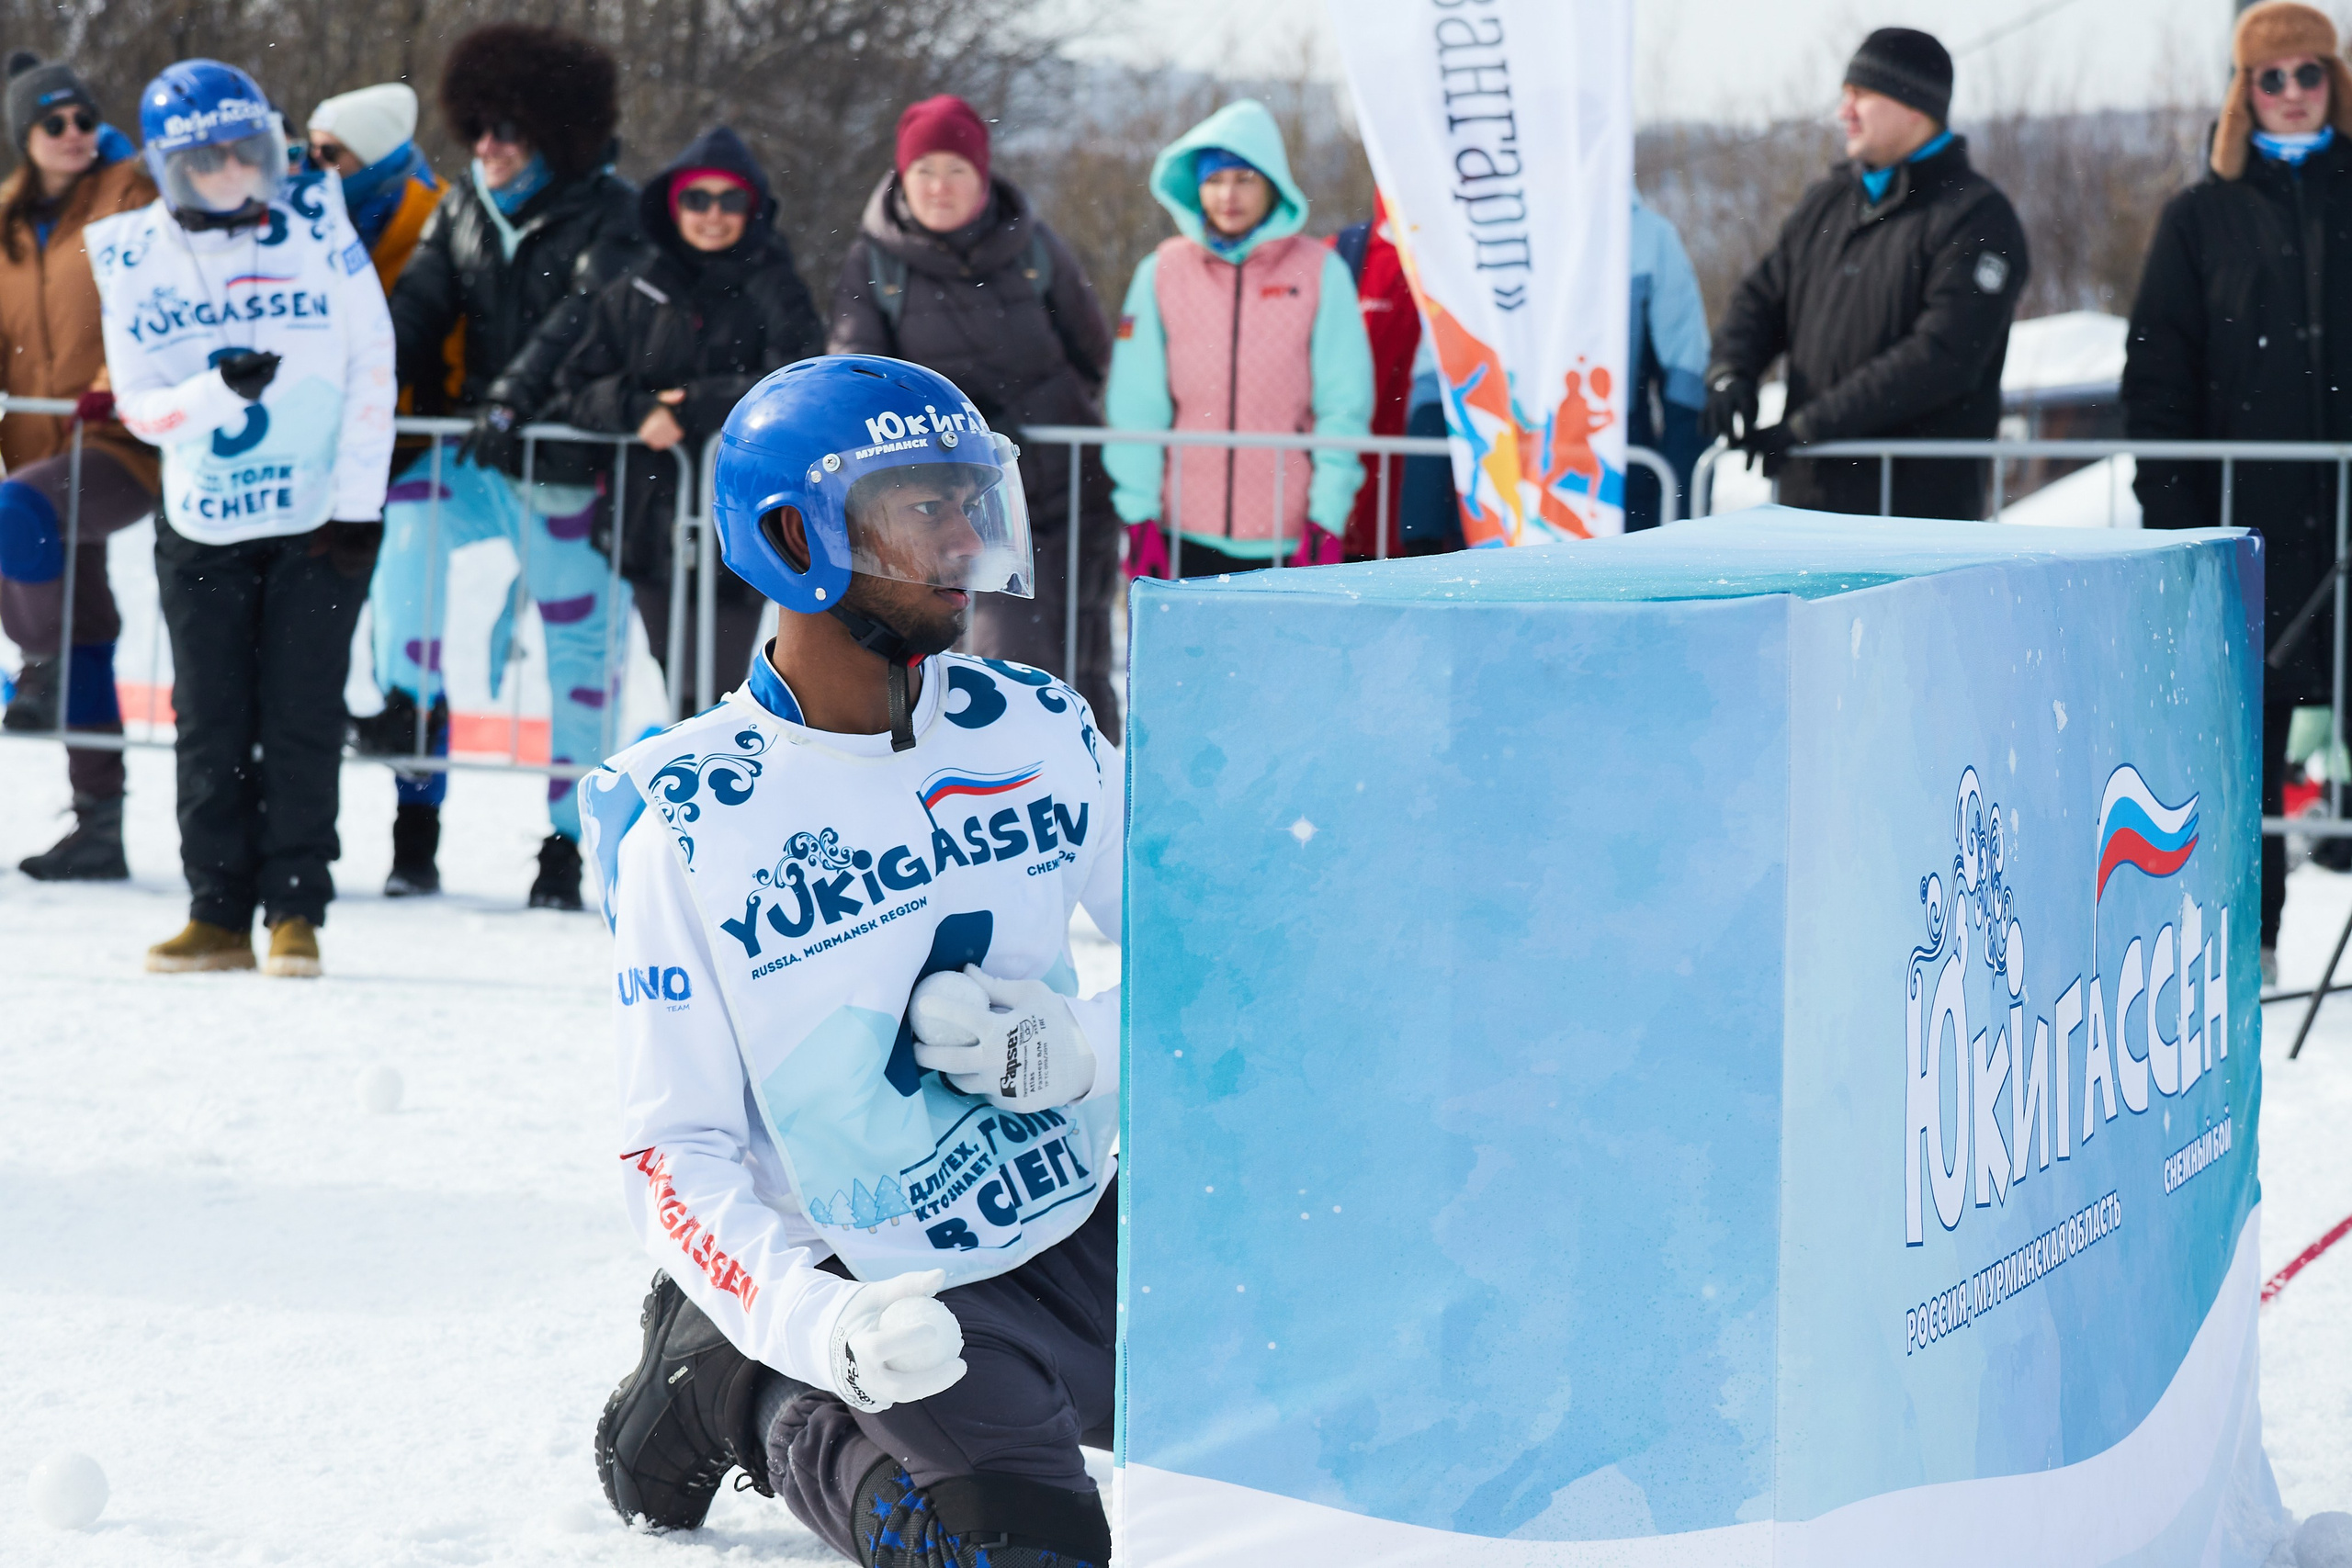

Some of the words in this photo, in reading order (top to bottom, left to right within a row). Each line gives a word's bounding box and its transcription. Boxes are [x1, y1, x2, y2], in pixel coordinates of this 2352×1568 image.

[1430, 0, 1532, 311] ангард»
[855, 438, 928, 460] МУРМАНСК
[1027, 857, 1060, 876] СНЕЖ
[1058, 851, 1076, 863] ОЙ
[752, 953, 802, 980] RUSSIA,
[803, 919, 878, 958] MURMANSK
[879, 896, 928, 925] REGION
[617, 964, 692, 1006] UNO
[666, 1004, 690, 1012] TEAM
[2164, 1115, 2212, 1197] СНЕЖНЫЙ
[2212, 1102, 2232, 1163] БОЙ
[914, 1194, 949, 1223] КТО
[947, 1152, 992, 1202] ЗНАЕТ
[619, 1145, 760, 1314] UKIGASSEN
[925, 1217, 978, 1250] В
[1905, 1280, 1972, 1357] РОССИЯ,
[1973, 1221, 2067, 1318] МУРМАНСКАЯ
[2067, 1190, 2122, 1258] ОБЛАСТЬ
